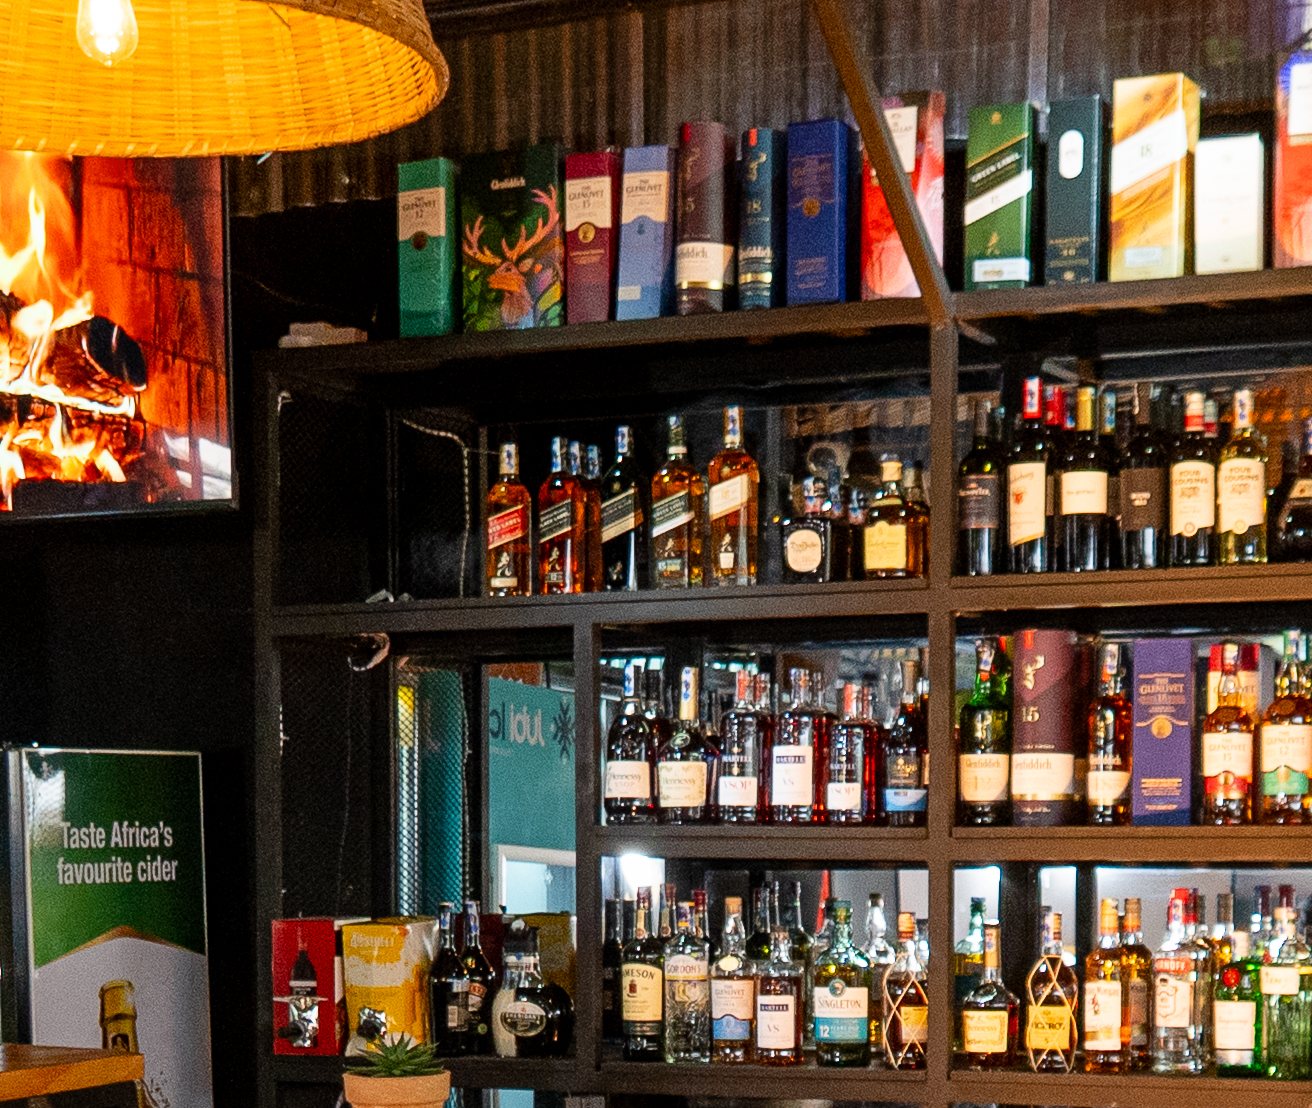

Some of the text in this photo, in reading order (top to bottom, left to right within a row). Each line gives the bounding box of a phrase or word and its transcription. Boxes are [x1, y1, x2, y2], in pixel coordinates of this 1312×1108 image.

[1021, 706, 1040, 723] 15
[60, 820, 174, 849] Taste Africa's
[57, 855, 178, 885] favourite cider
[667, 964, 701, 974] GORDON'S
[817, 997, 862, 1009] SINGLETON
[767, 1024, 780, 1033] VS
[819, 1025, 830, 1038] 12
